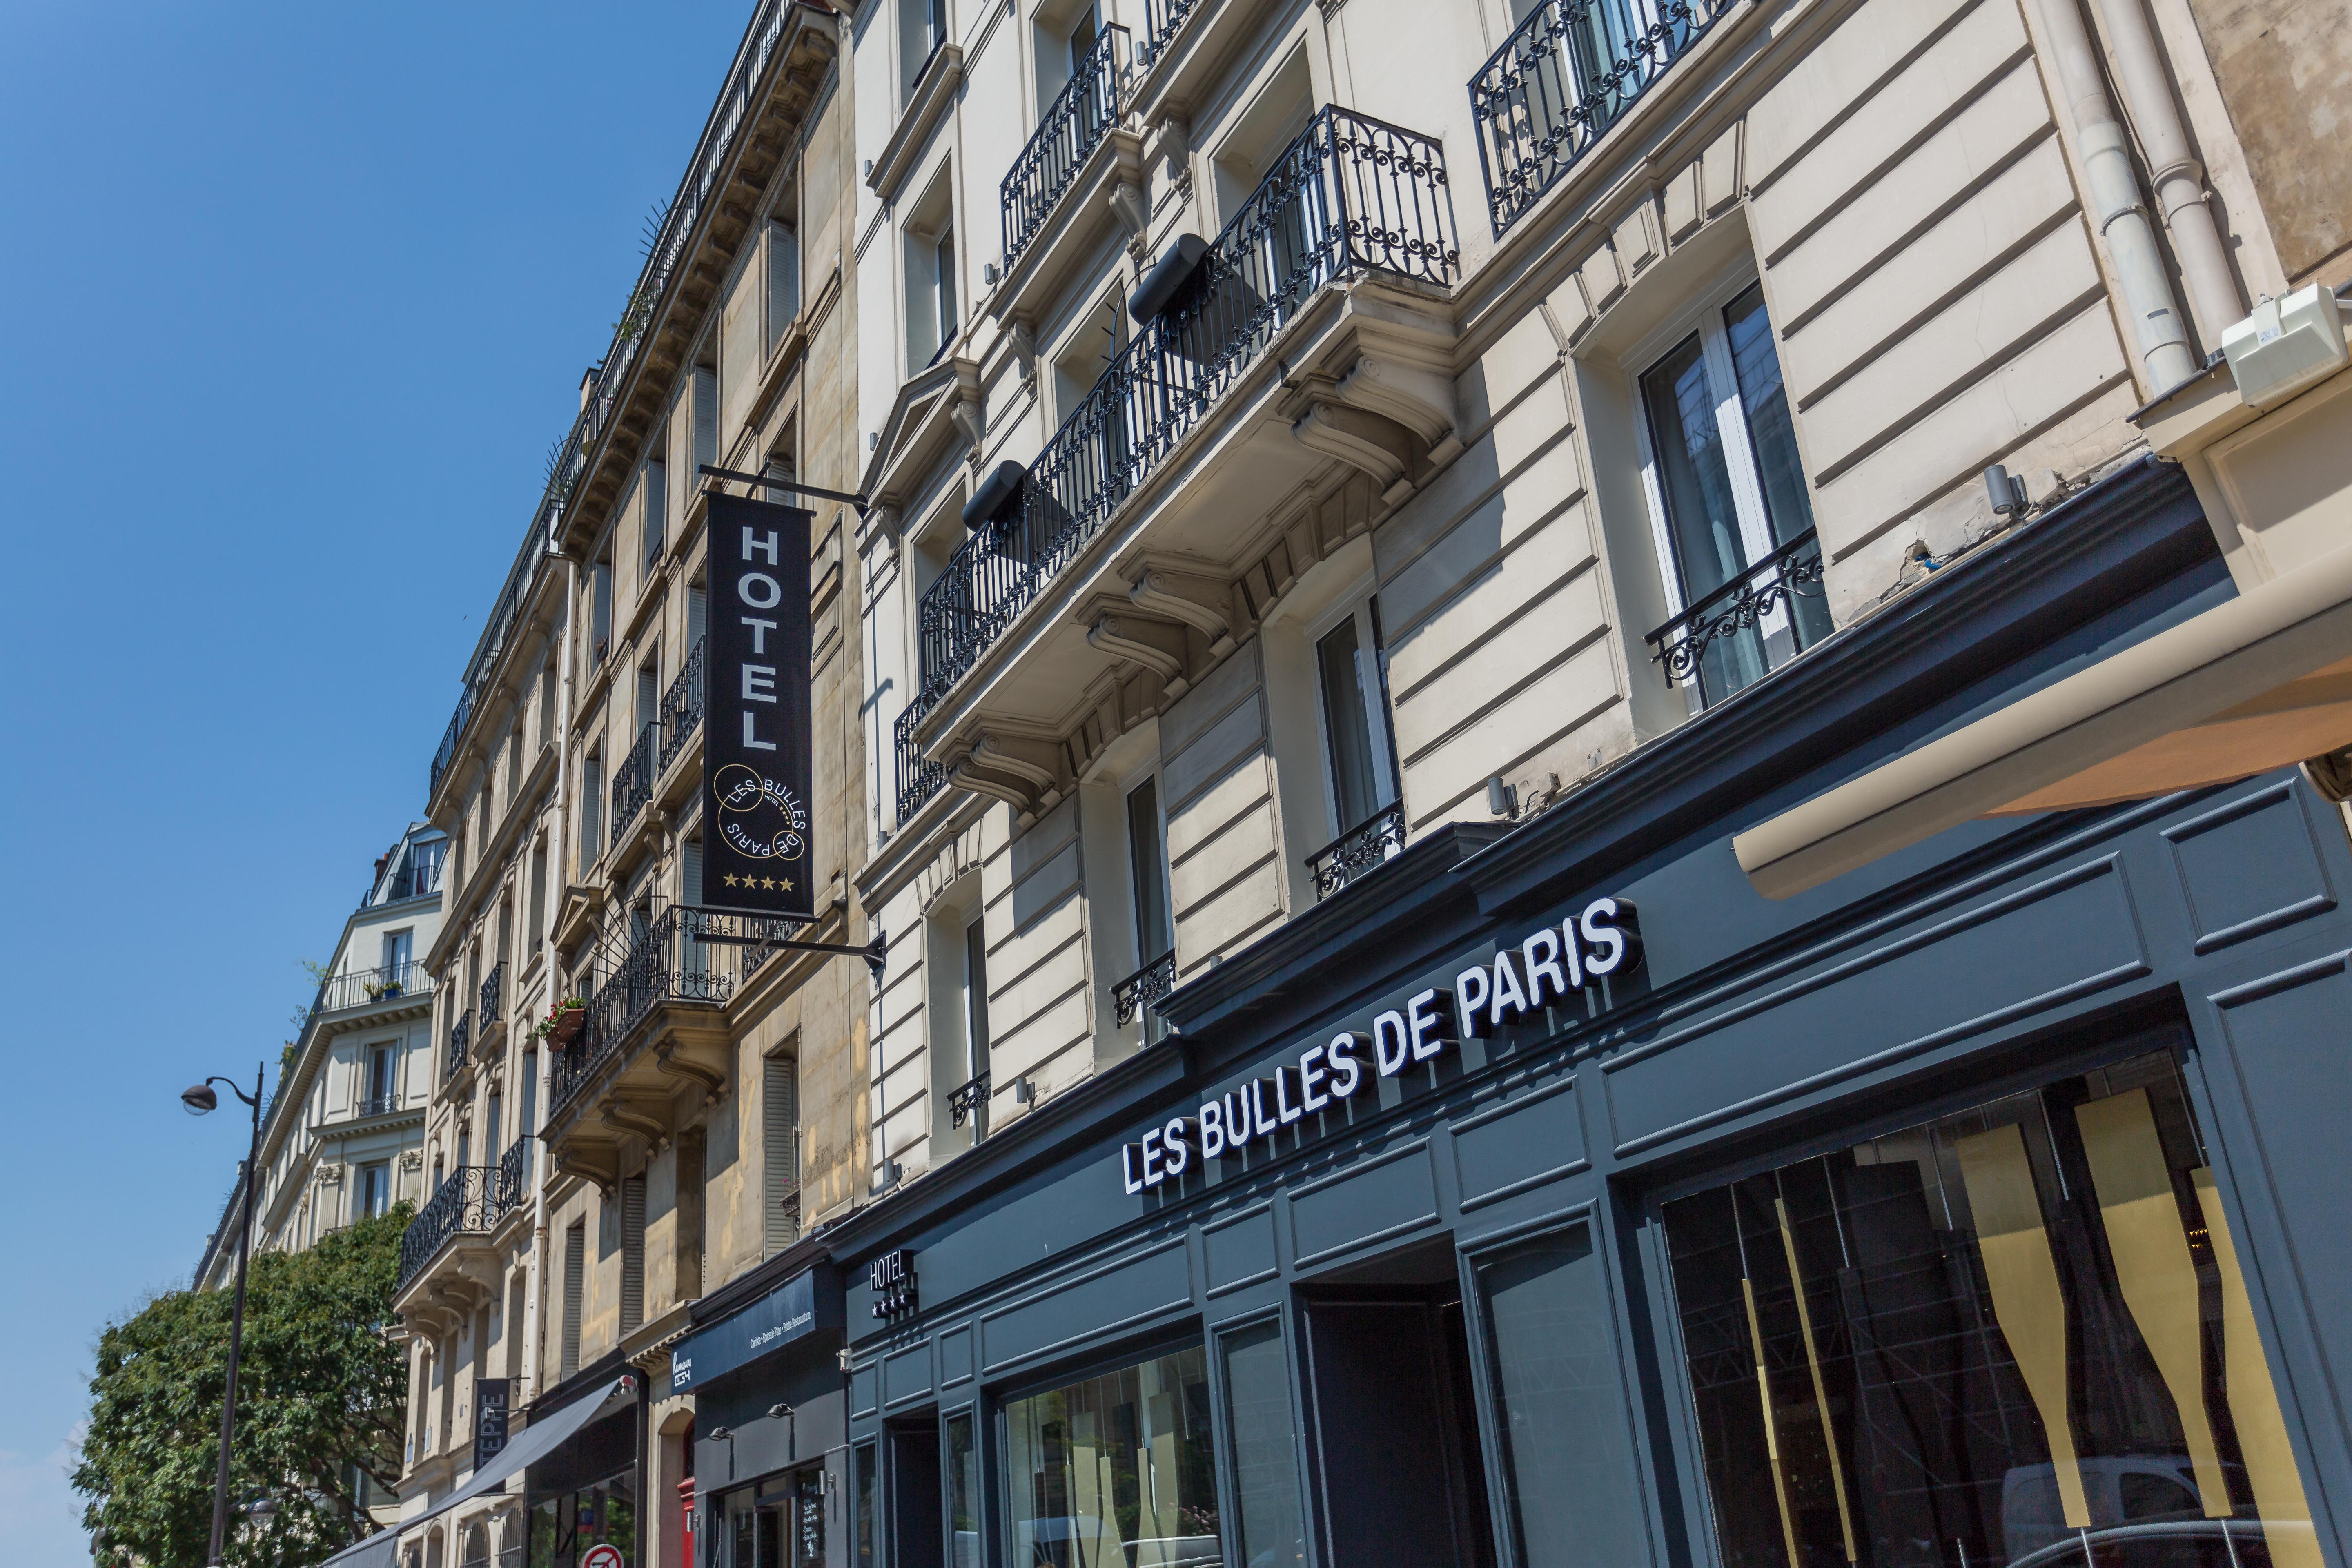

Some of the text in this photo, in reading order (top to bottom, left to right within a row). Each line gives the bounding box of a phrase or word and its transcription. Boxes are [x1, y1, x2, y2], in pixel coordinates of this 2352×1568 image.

[737, 526, 782, 751] HOTEL
[727, 778, 806, 856] LES BULLES DE PARIS
[764, 794, 779, 806] HOTEL
[1123, 897, 1624, 1195] LES BULLES DE PARIS
[870, 1250, 905, 1291] HOTEL
